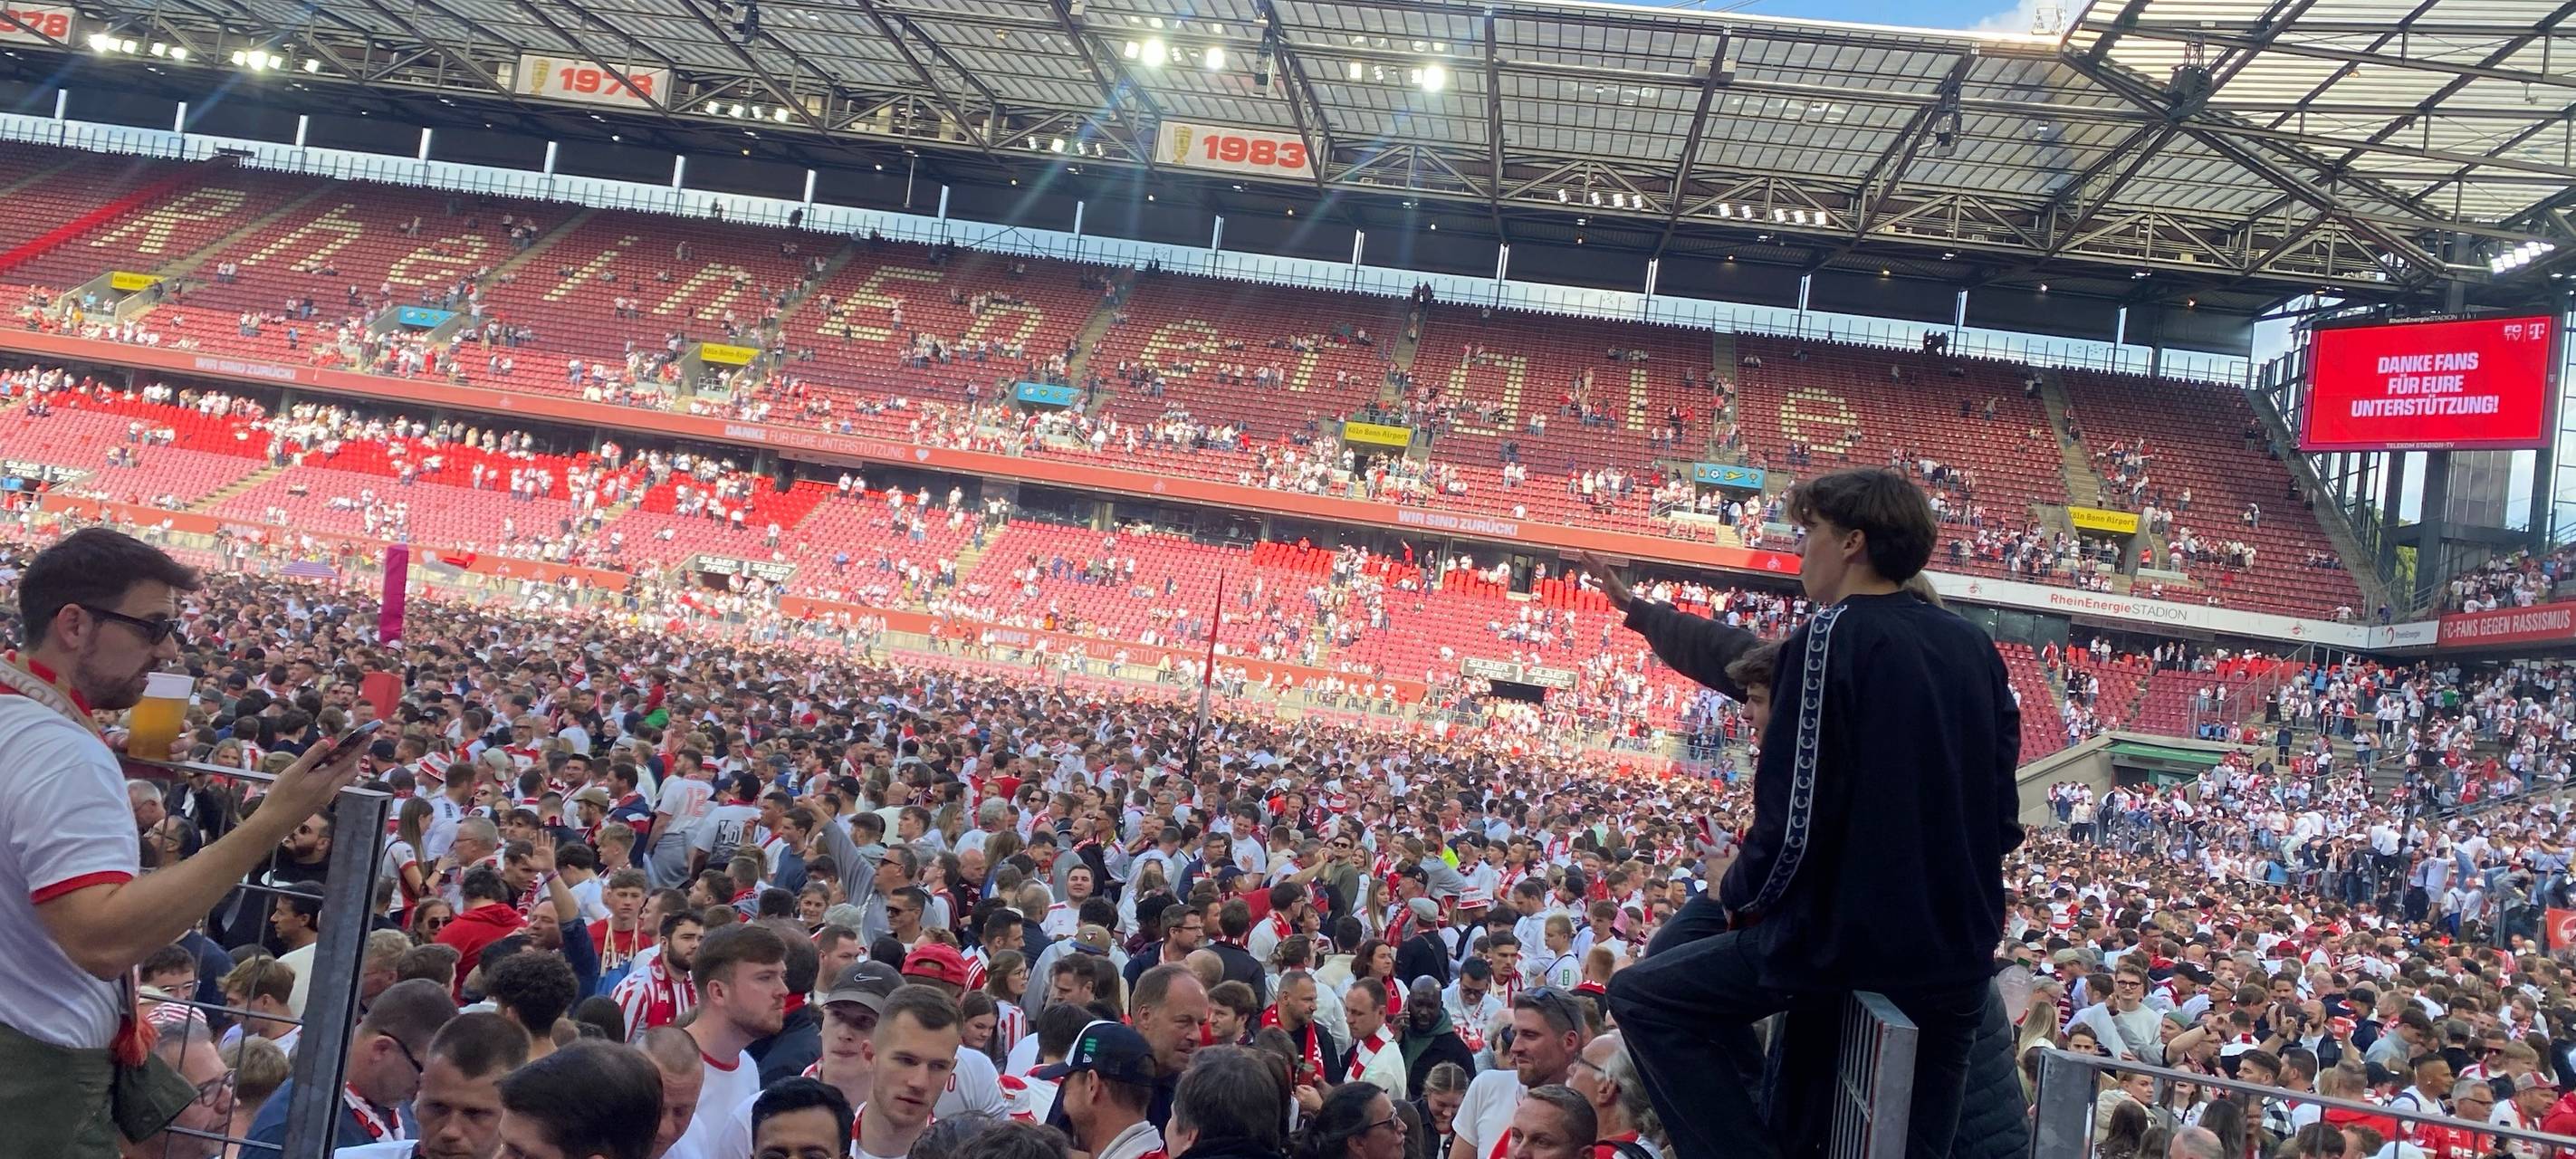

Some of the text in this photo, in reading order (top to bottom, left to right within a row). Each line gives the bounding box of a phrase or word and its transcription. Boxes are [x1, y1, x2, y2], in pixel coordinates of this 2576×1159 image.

[560, 68, 653, 98] 1978
[1203, 135, 1307, 168] 1983
[2504, 325, 2522, 333] FC
[2504, 332, 2521, 341] TV
[2378, 352, 2478, 374] DANKE FANS
[2387, 373, 2464, 395] FÜR EURE
[2351, 395, 2499, 417] UNTERSTÜTZUNG!
[725, 425, 767, 441] DANKE
[1382, 430, 1408, 440] Airport
[1399, 509, 1518, 536] WIR SIND ZURÜCK!
[2070, 512, 2085, 521] öln
[2106, 515, 2134, 526] Airport
[2050, 593, 2188, 621] RheinEnergieSTADION
[2443, 609, 2571, 637] FC-FANS GEGEN RASSISMUS
[1468, 659, 1509, 672] SILBER
[1527, 668, 1568, 680] SILBER
